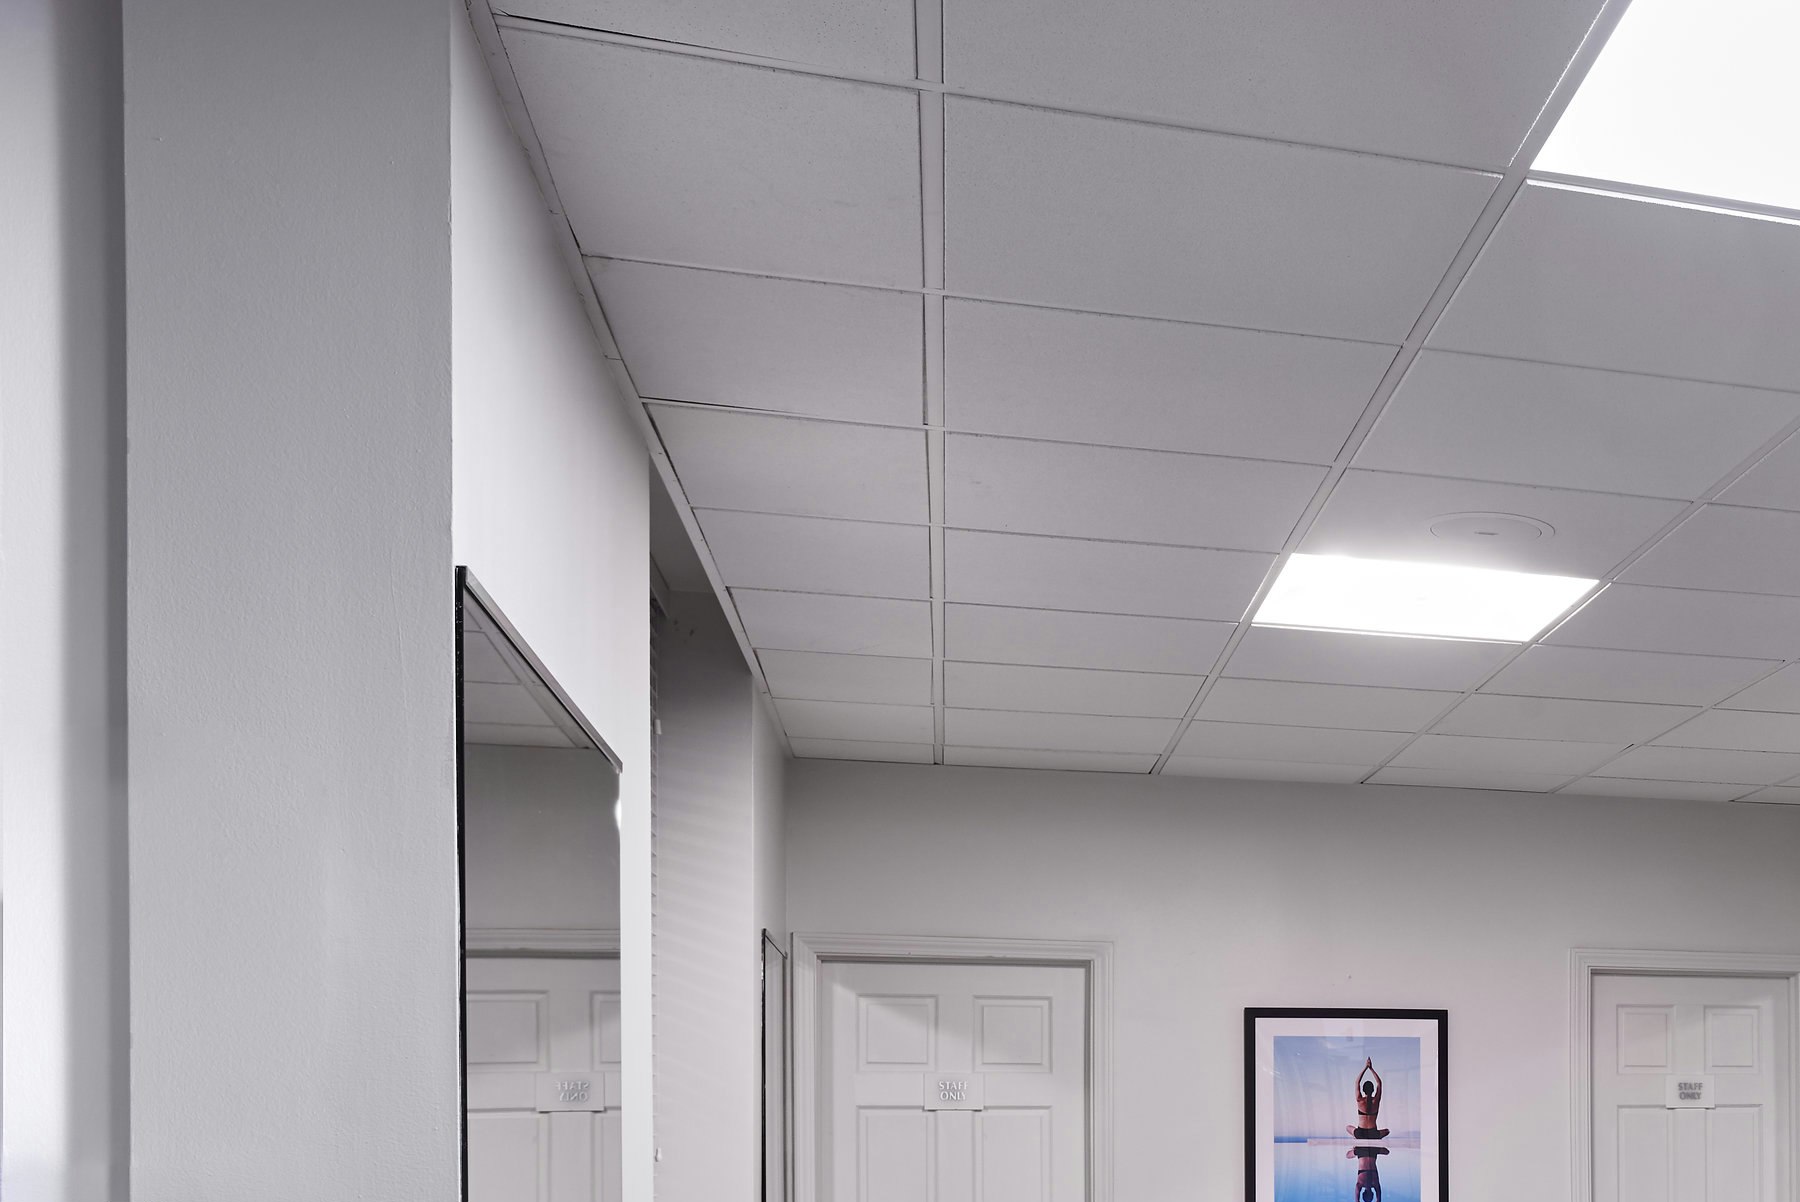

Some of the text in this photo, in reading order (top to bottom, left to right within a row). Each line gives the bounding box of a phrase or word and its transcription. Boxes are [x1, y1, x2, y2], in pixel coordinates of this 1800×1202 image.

[938, 1081, 968, 1090] STAFF
[1678, 1082, 1703, 1091] STAFF
[940, 1091, 966, 1100] ONLY
[1679, 1091, 1702, 1100] ONLY
